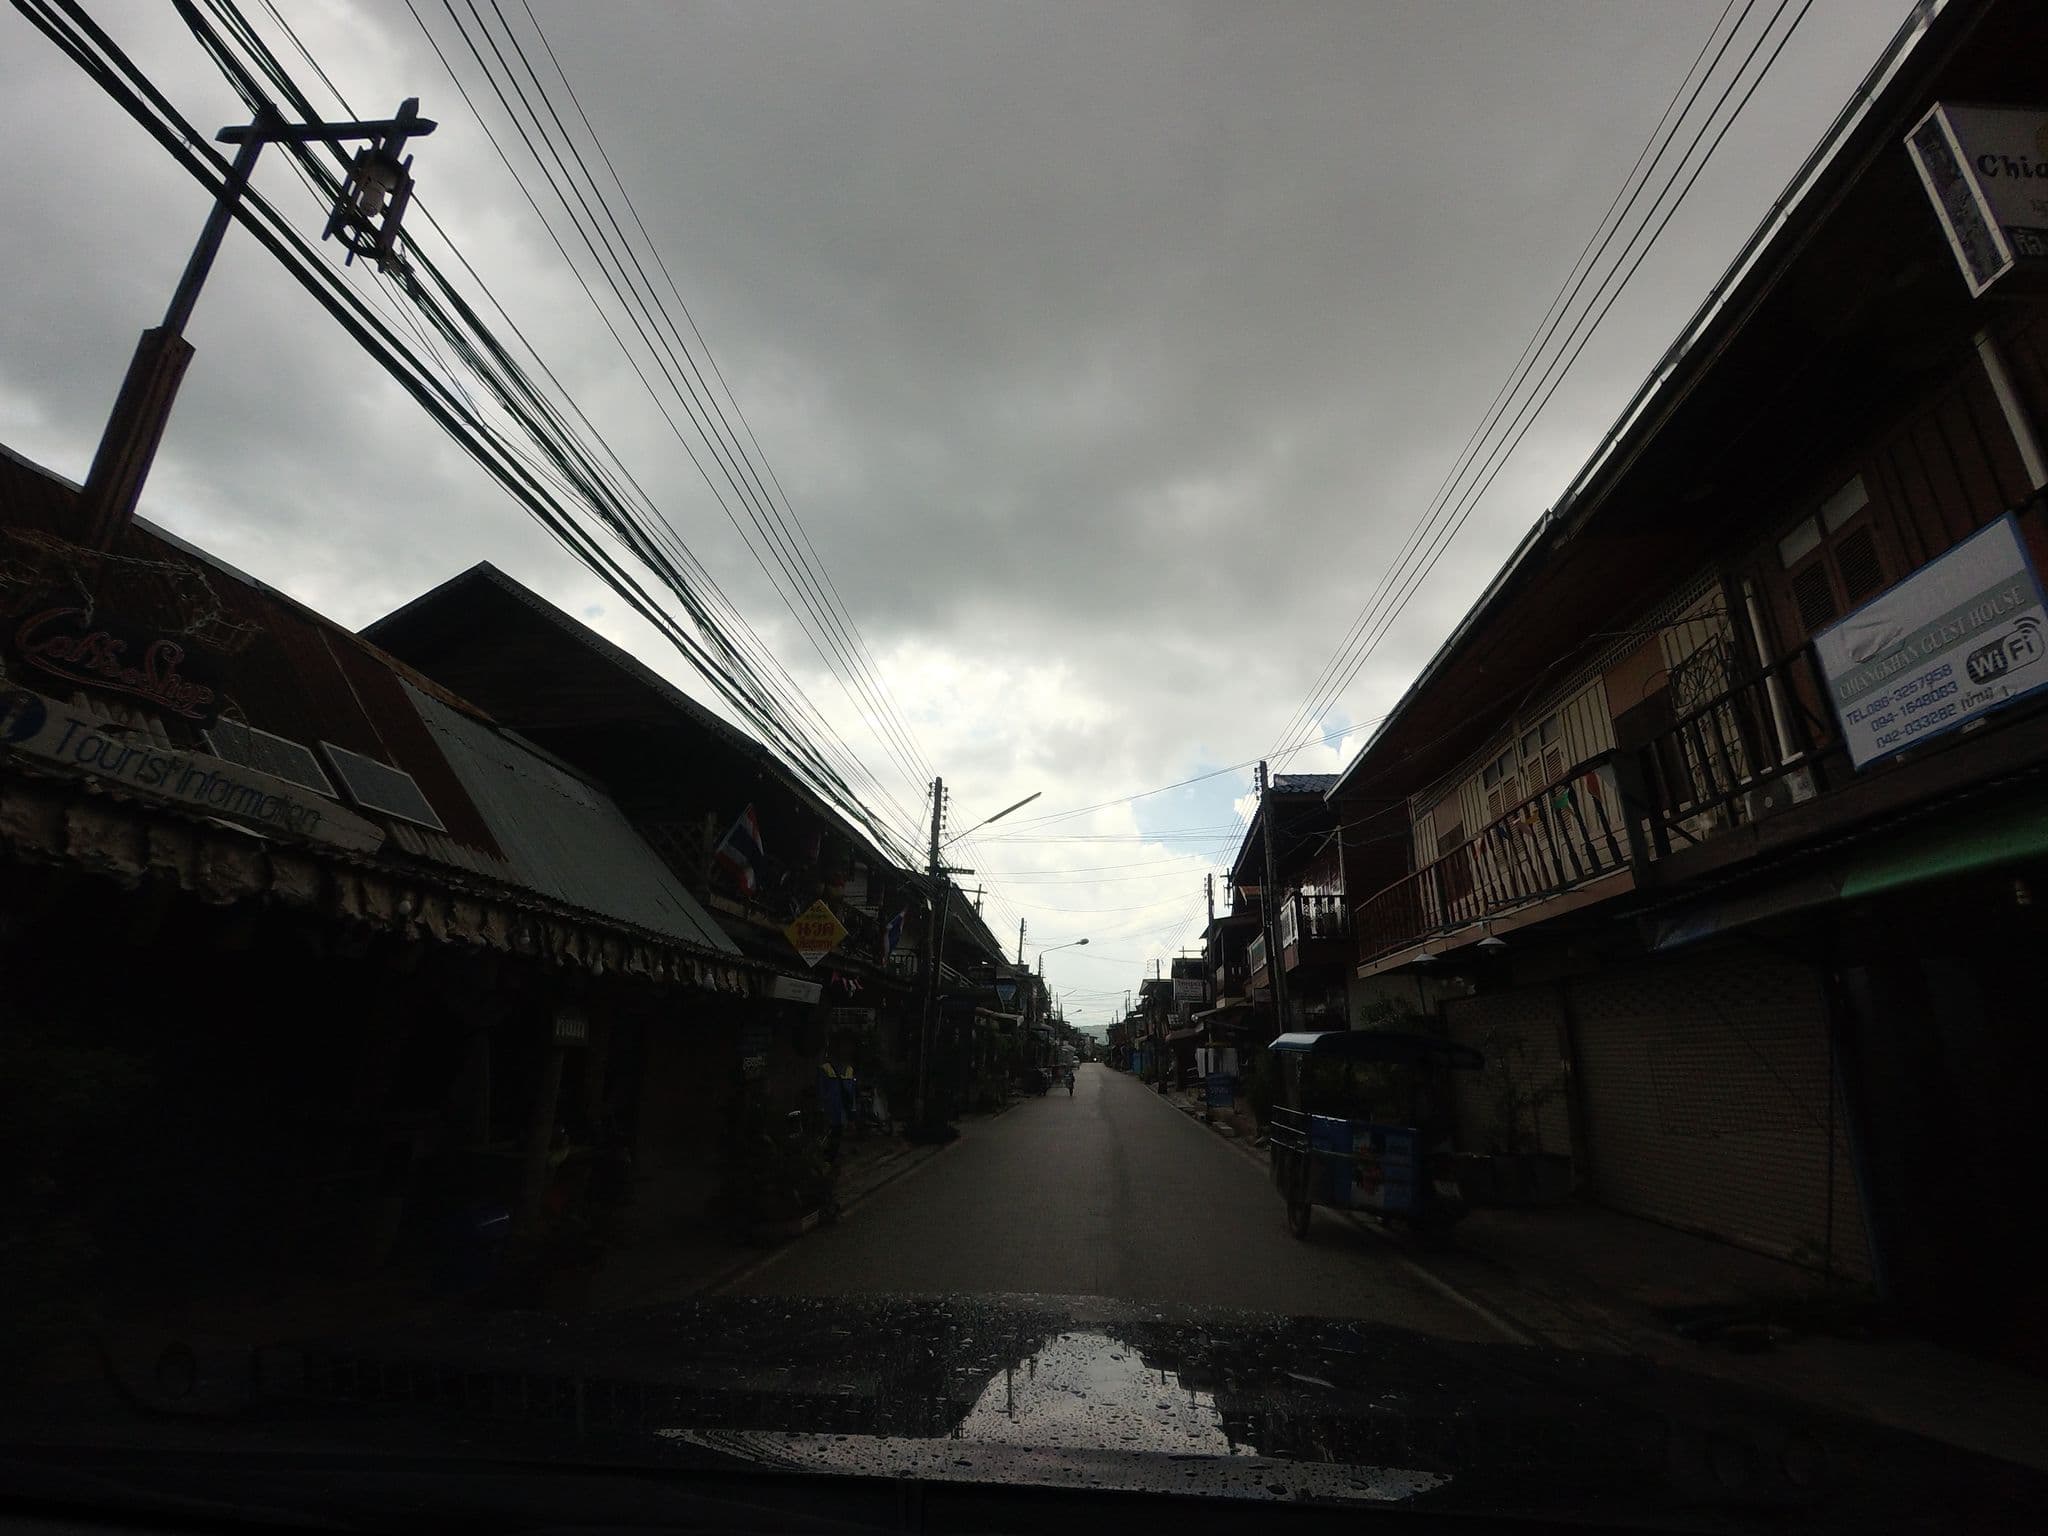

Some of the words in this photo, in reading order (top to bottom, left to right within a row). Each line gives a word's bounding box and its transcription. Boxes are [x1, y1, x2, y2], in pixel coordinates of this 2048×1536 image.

[1920, 623, 1966, 654] GUEST
[1969, 585, 2026, 629] HOUSE
[56, 718, 178, 787] Tourist
[176, 762, 323, 833] Information
